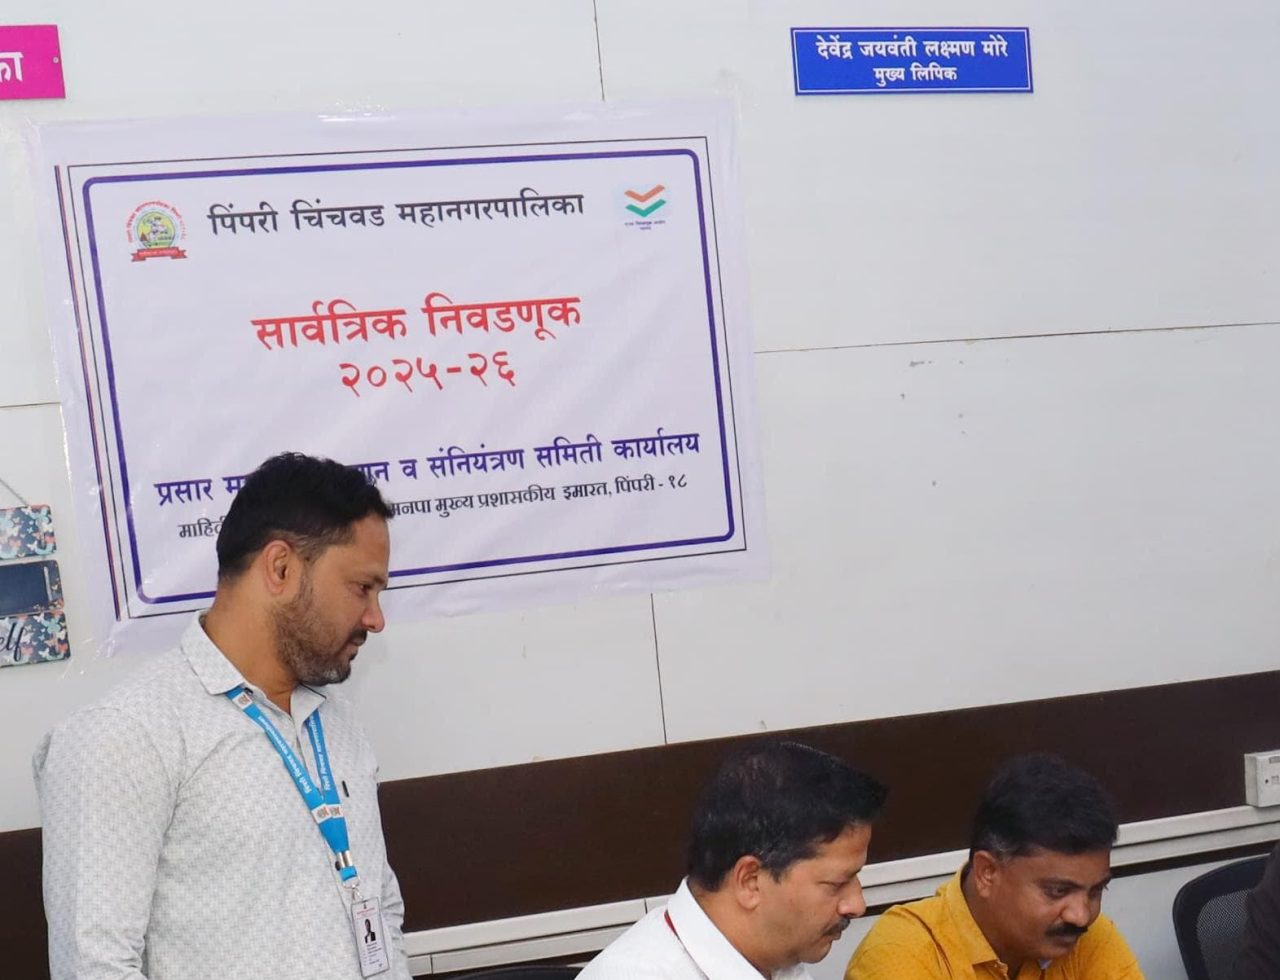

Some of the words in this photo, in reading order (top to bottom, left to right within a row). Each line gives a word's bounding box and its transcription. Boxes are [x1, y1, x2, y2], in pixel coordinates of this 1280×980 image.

[815, 35, 853, 60] देवेंद्र
[858, 34, 917, 58] जयवंती
[923, 39, 976, 57] लक्ष्मण
[981, 34, 1008, 58] मोरे
[873, 66, 905, 87] मुख्य
[910, 61, 957, 81] लिपिक
[206, 201, 279, 236] पिंपरी
[289, 197, 386, 231] चिंचवड
[395, 187, 585, 228] महानगरपालिका
[250, 299, 407, 350] सार्वत्रिक
[421, 292, 581, 341] निवडणूक
[339, 350, 516, 397] २०२५-२६
[153, 478, 214, 506] प्रसार
[398, 458, 418, 480] व
[426, 443, 525, 479] संनियंत्रण
[533, 433, 602, 468] समिती
[611, 427, 700, 460] कार्यालय
[435, 495, 474, 518] मुख्य
[477, 483, 556, 509] प्रशासकीय
[562, 482, 612, 500] इमारत,
[615, 474, 655, 494] पिंपरी
[668, 474, 688, 489] १८
